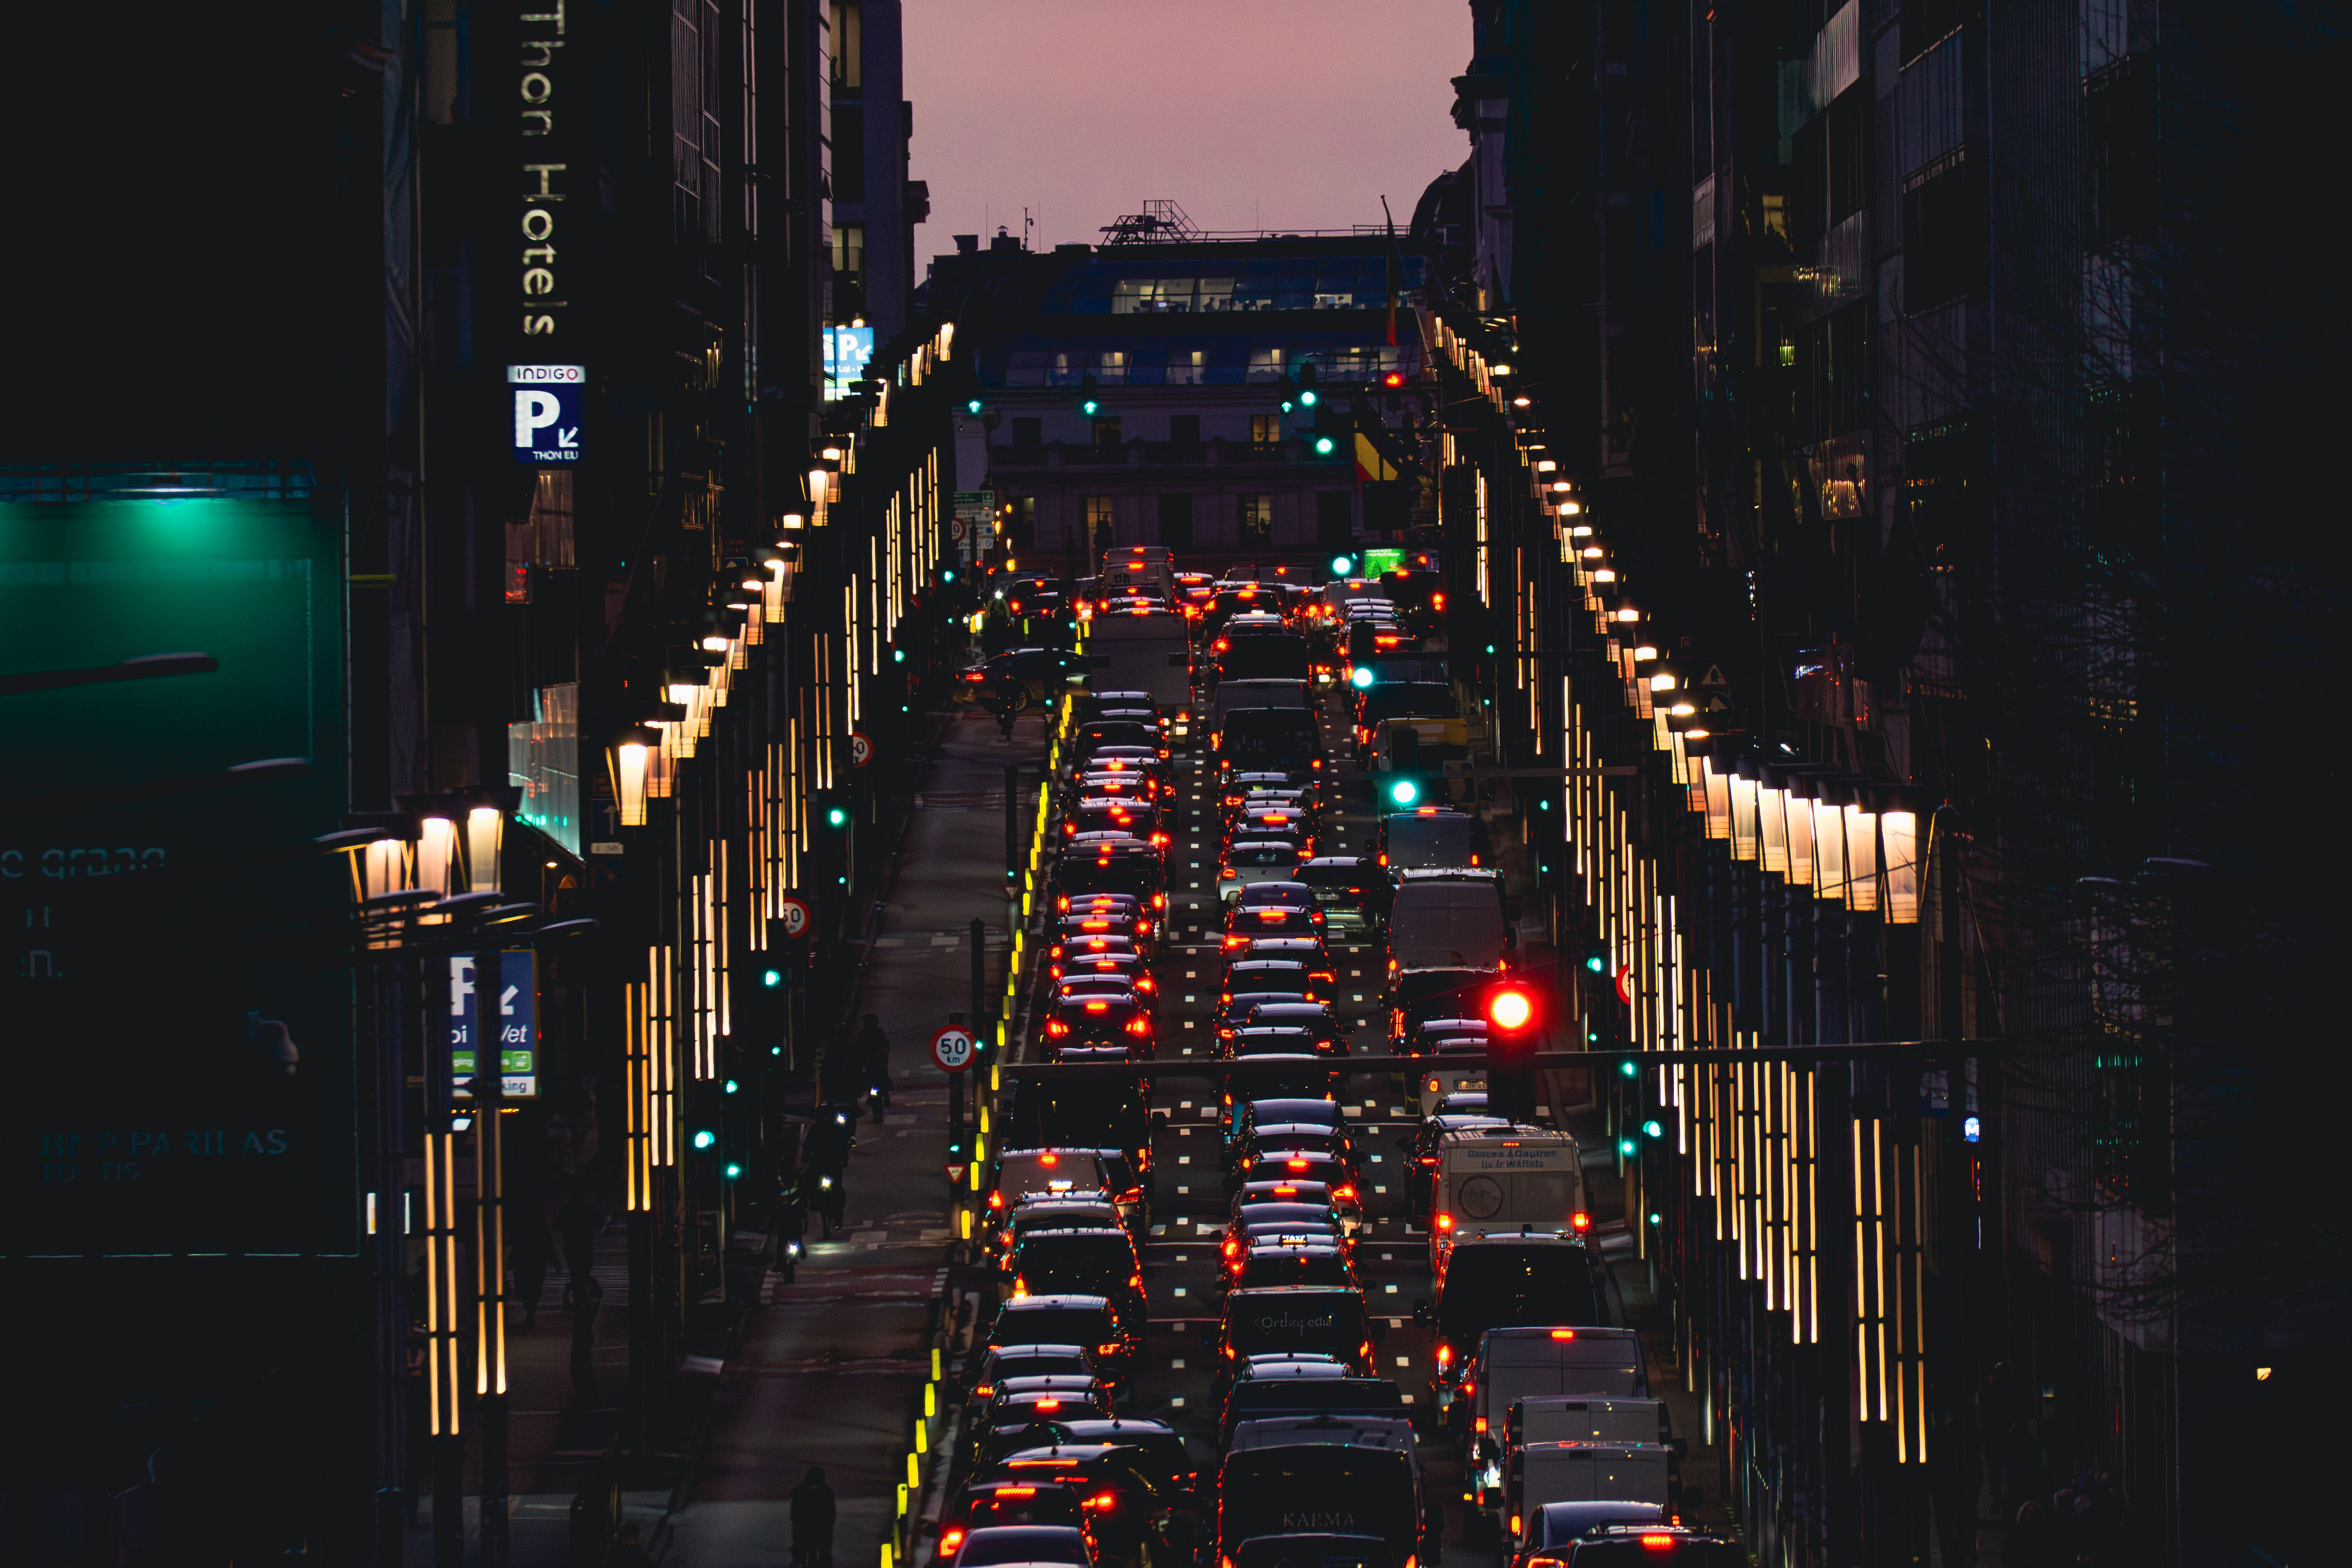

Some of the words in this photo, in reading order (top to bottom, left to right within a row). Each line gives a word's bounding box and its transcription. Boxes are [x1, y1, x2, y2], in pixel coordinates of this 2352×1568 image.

[520, 0, 565, 135] Thon
[522, 164, 567, 335] Hotels
[839, 334, 858, 361] P
[518, 368, 578, 380] INDIGO
[515, 391, 560, 447] P
[532, 450, 562, 460] THON
[451, 1025, 467, 1044] oi
[941, 1038, 966, 1054] 50
[42, 1163, 140, 1182] FOTIS
[1283, 1512, 1354, 1527] KARMA
